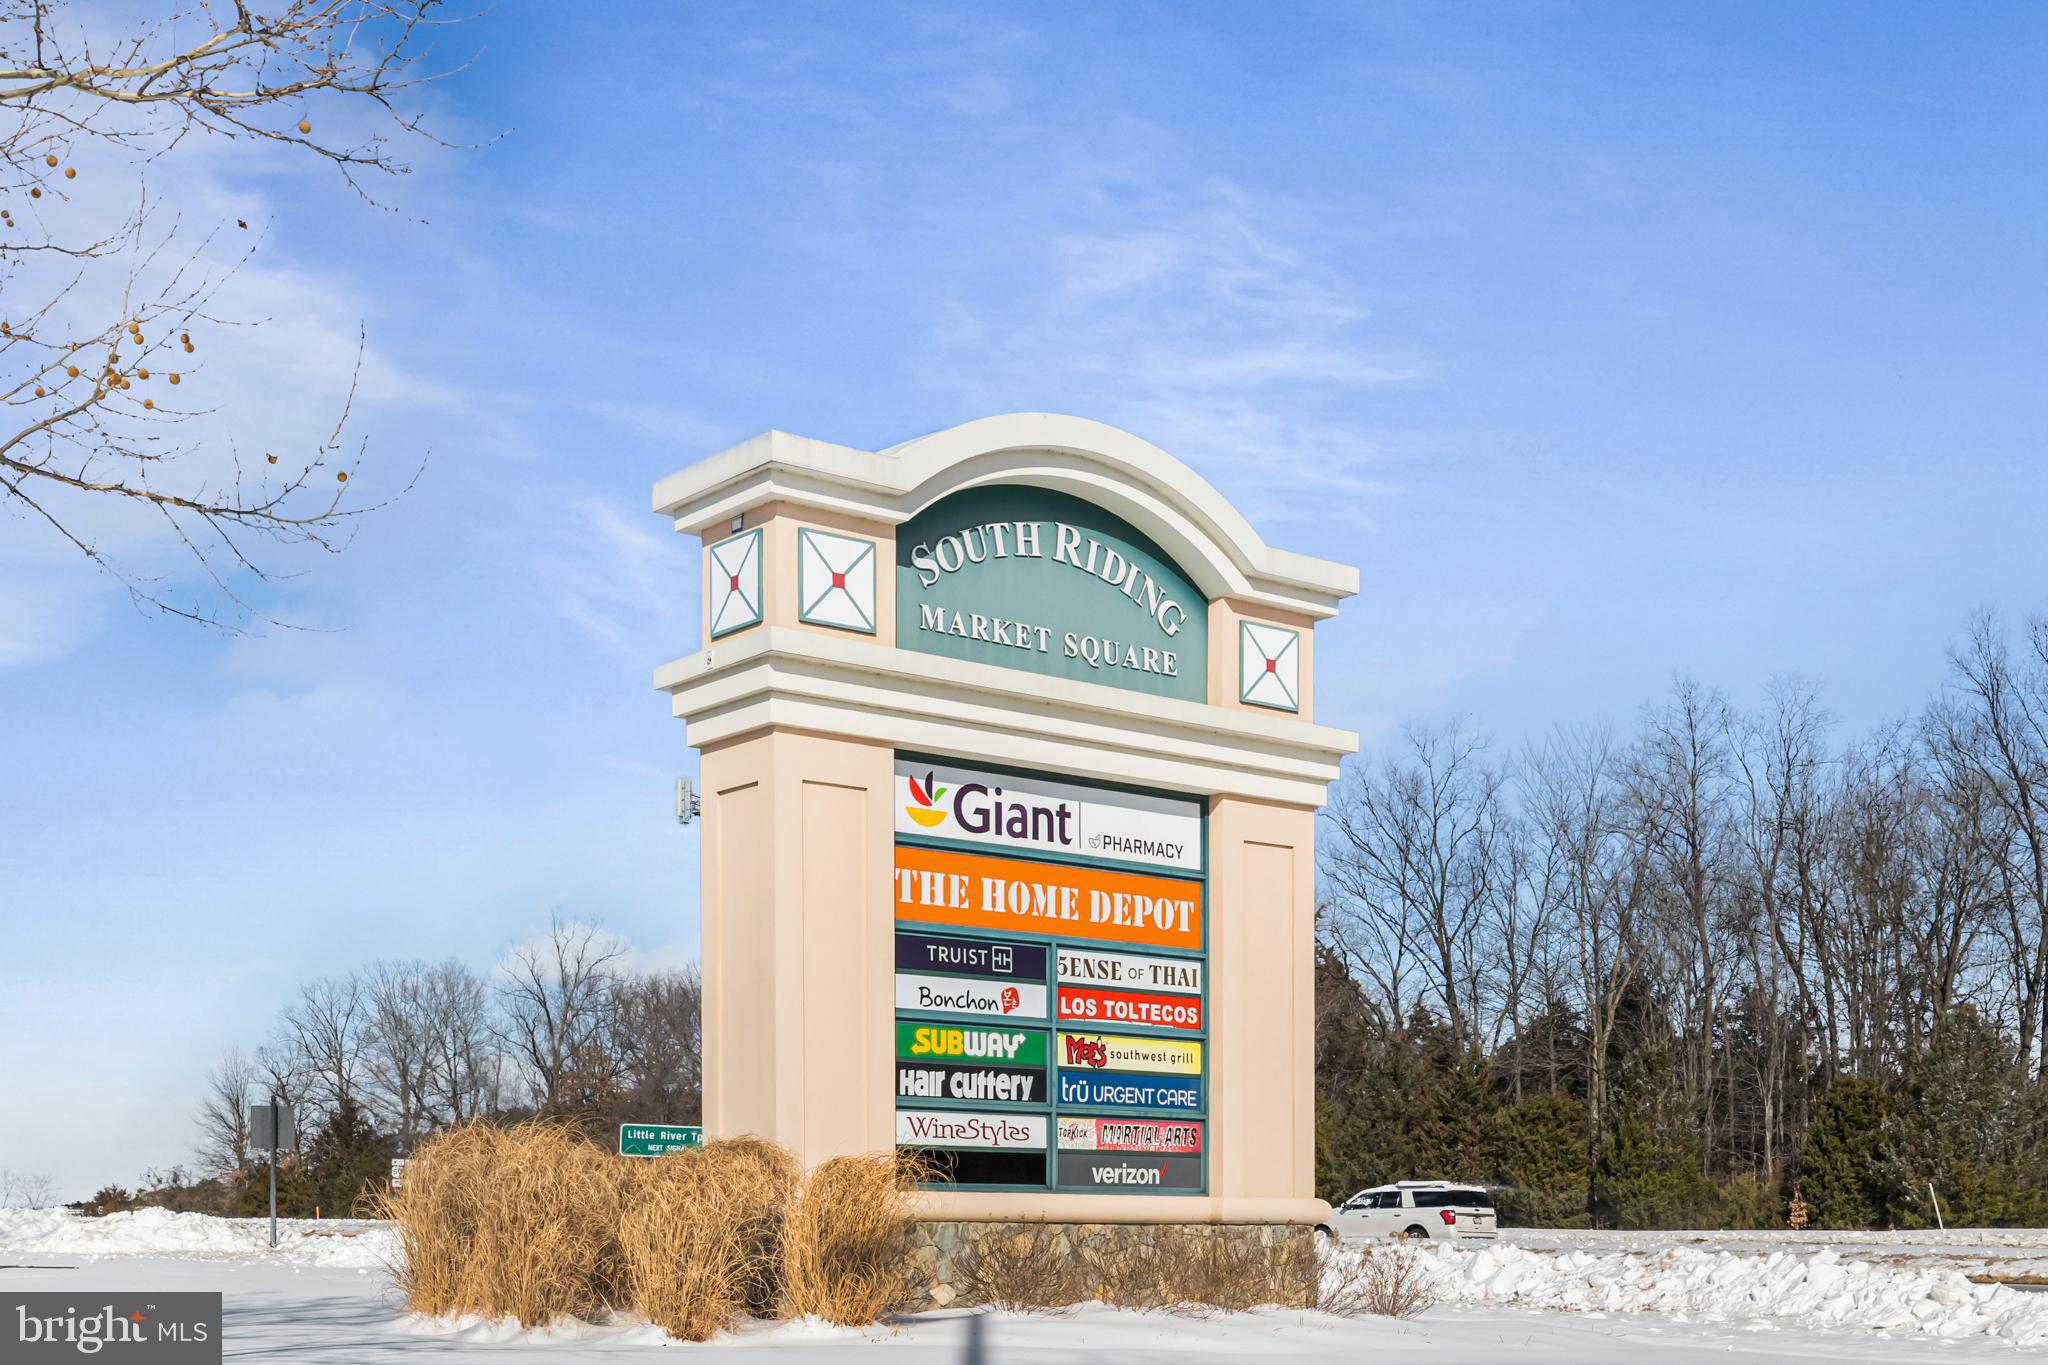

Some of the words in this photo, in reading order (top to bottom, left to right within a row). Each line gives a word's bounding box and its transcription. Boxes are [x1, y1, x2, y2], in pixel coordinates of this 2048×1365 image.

[910, 521, 1043, 588] SOUTH
[1052, 522, 1187, 637] RIDING
[919, 603, 1051, 653] MARKET
[1064, 632, 1178, 677] SQUARE
[953, 783, 1072, 845] Giant
[1103, 835, 1184, 859] PHARMACY
[895, 867, 969, 910] THE
[981, 877, 1079, 921] HOME
[1089, 889, 1195, 933] DEPOT
[926, 945, 988, 966] TRUIST
[1128, 967, 1144, 980] OF
[1149, 964, 1198, 988] THAI
[918, 986, 999, 1011] Bonchon
[1060, 996, 1097, 1017] LOS
[1103, 1000, 1198, 1024] TOLTECOS
[910, 1027, 1026, 1059] SUBWAY
[1110, 1049, 1167, 1062] southwest
[1170, 1053, 1193, 1065] grill
[899, 1068, 946, 1097] Hair
[1062, 1076, 1089, 1102] trü
[1093, 1085, 1155, 1104] URGENT
[1156, 1088, 1197, 1107] CARE
[627, 1129, 655, 1140] Little
[660, 1131, 687, 1140] River
[907, 1116, 1030, 1146] WineStyles
[1101, 1124, 1159, 1145] MARTIAL
[1164, 1126, 1197, 1147] ARTS
[1091, 1163, 1160, 1185] verizon
